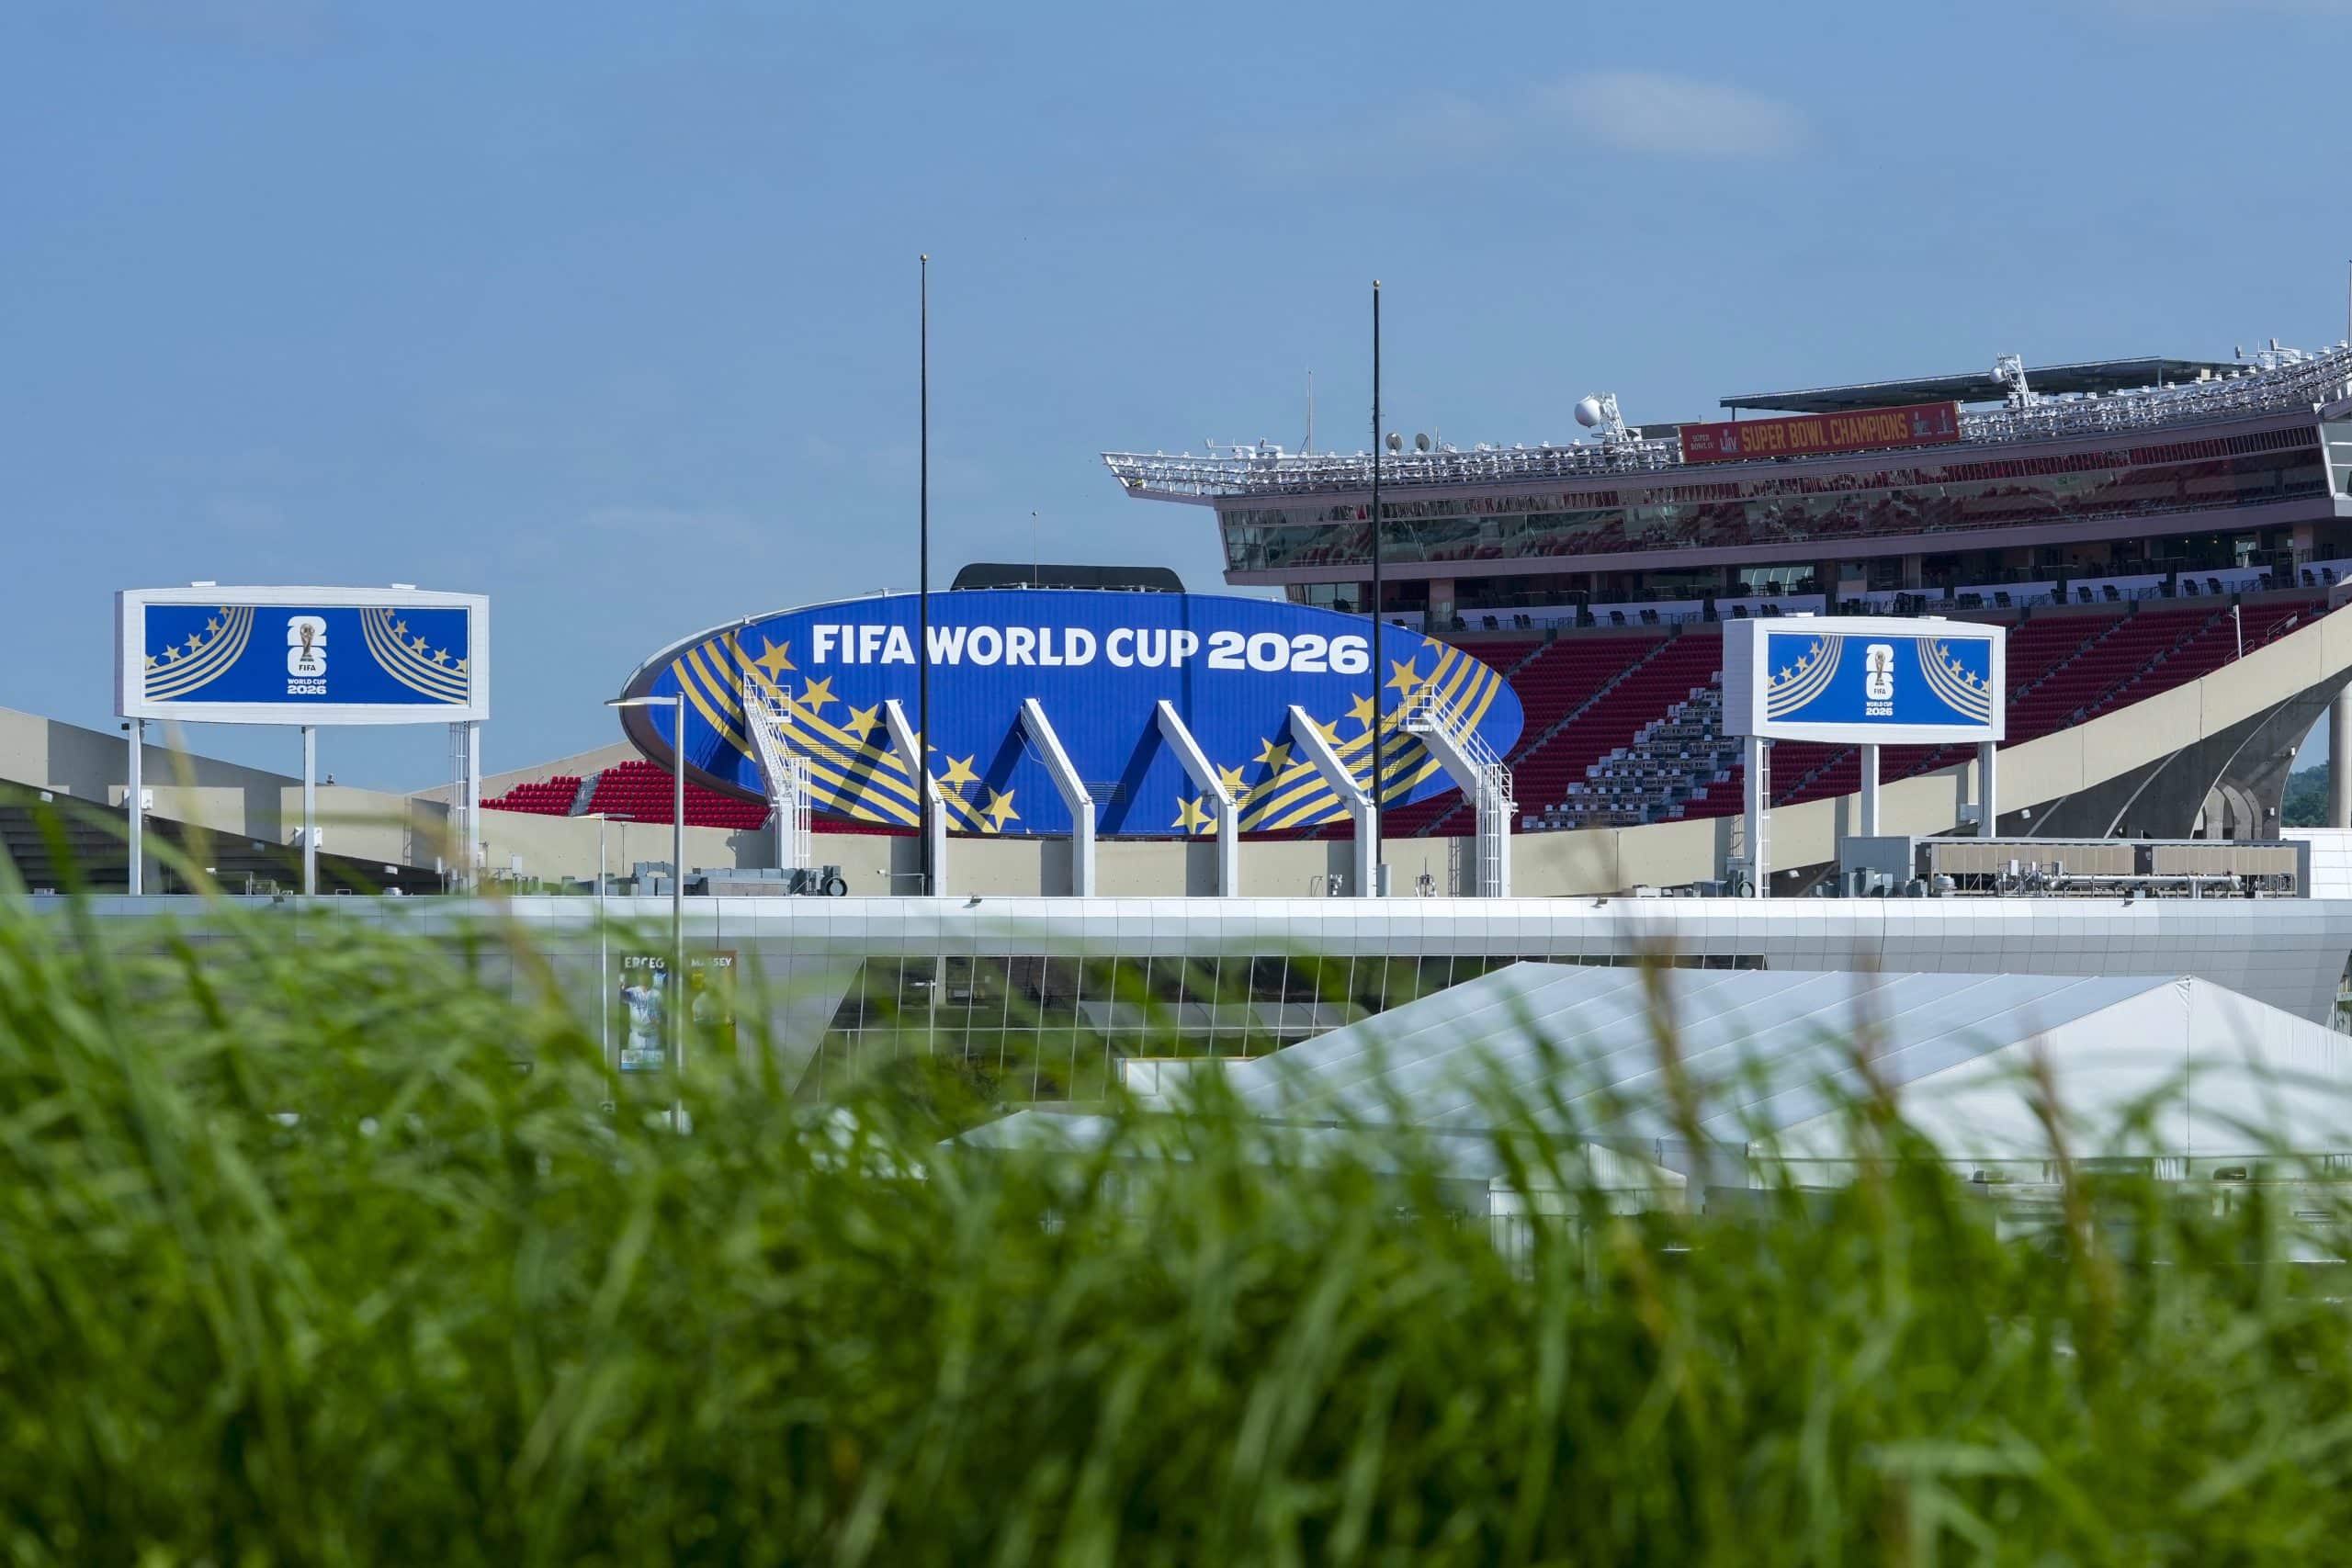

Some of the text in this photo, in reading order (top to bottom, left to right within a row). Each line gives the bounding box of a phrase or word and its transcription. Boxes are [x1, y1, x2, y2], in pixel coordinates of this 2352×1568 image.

[1741, 423, 1786, 452] SUPER
[1791, 420, 1828, 447] BOWL
[1829, 413, 1908, 445] CHAMPIONS
[812, 625, 1369, 675] FIFA WORLD CUP 2026
[287, 685, 327, 694] 2026
[1866, 707, 1894, 716] 2026
[691, 957, 732, 967] MSEY
